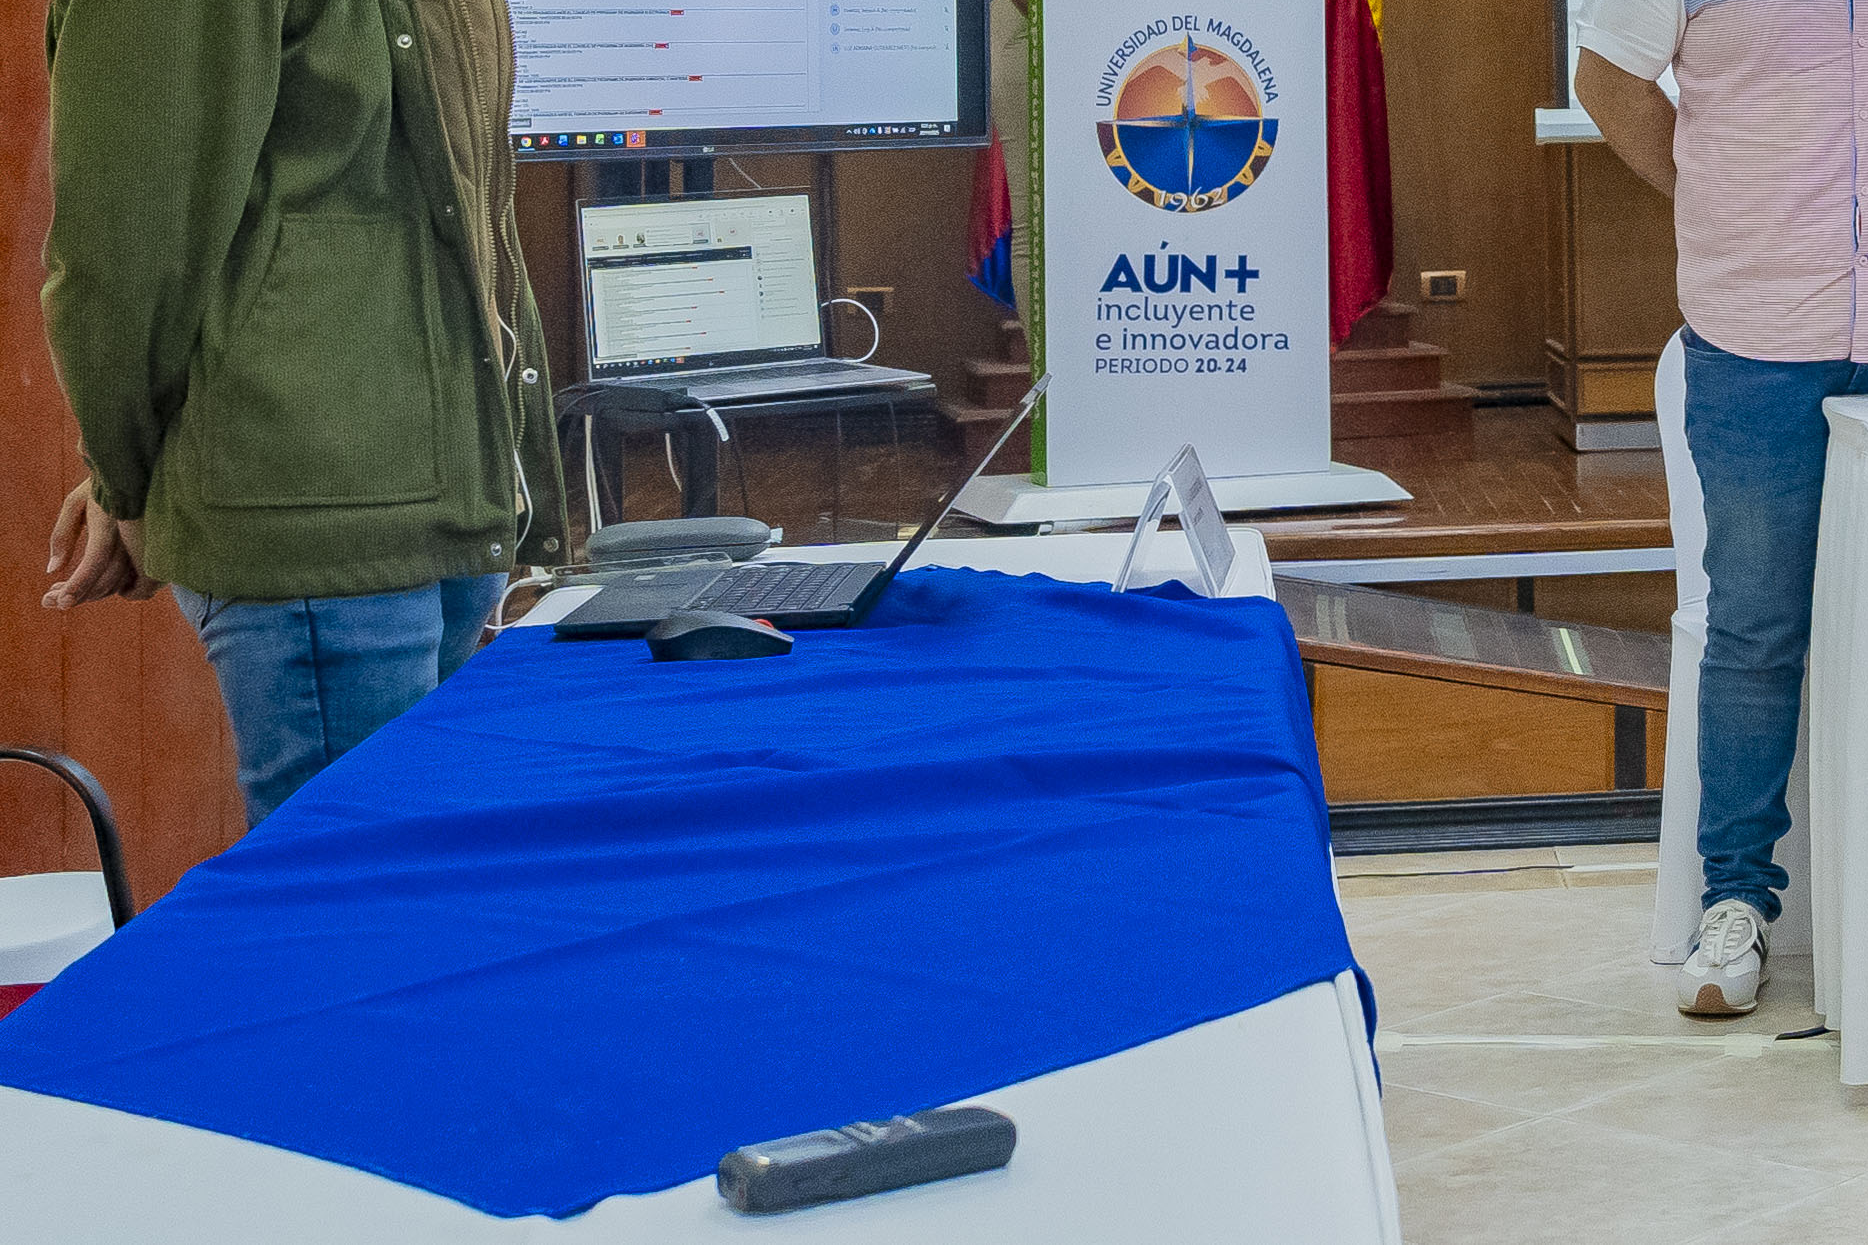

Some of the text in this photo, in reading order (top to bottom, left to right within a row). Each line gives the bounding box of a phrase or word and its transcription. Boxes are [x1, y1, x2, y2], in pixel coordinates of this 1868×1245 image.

[1096, 15, 1279, 107] UNIVERSIDAD DEL MAGDALENA
[1159, 186, 1224, 212] 1962
[1096, 296, 1255, 329] incluyente
[1095, 326, 1290, 351] e innovadora
[1095, 358, 1189, 374] PERIODO
